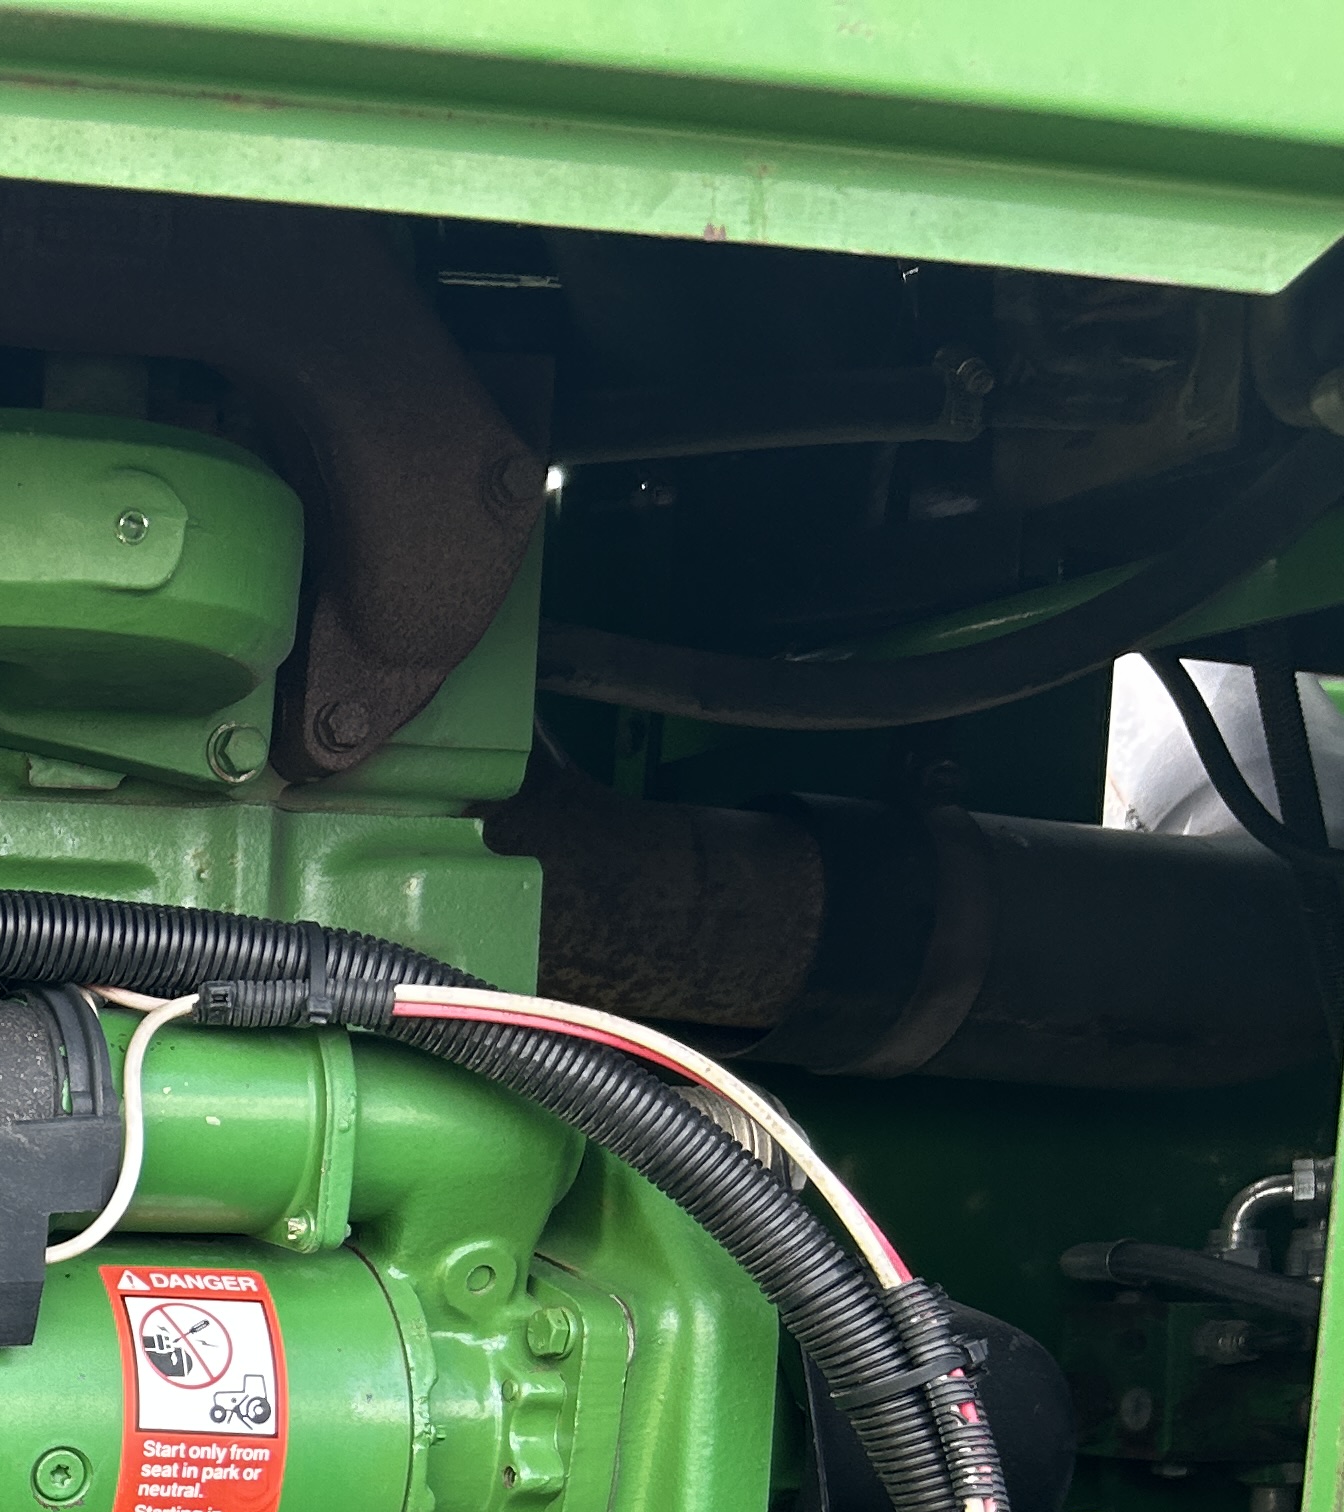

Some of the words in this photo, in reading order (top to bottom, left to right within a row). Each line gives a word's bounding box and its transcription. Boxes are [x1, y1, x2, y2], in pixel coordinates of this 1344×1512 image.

[149, 1273, 258, 1292] DANGER
[143, 1439, 186, 1458] Start
[188, 1443, 227, 1464] only
[230, 1444, 270, 1461] from
[140, 1463, 179, 1478] seat
[182, 1462, 198, 1478] in
[201, 1464, 240, 1483] park
[242, 1468, 263, 1481] or
[137, 1482, 204, 1498] neutral.
